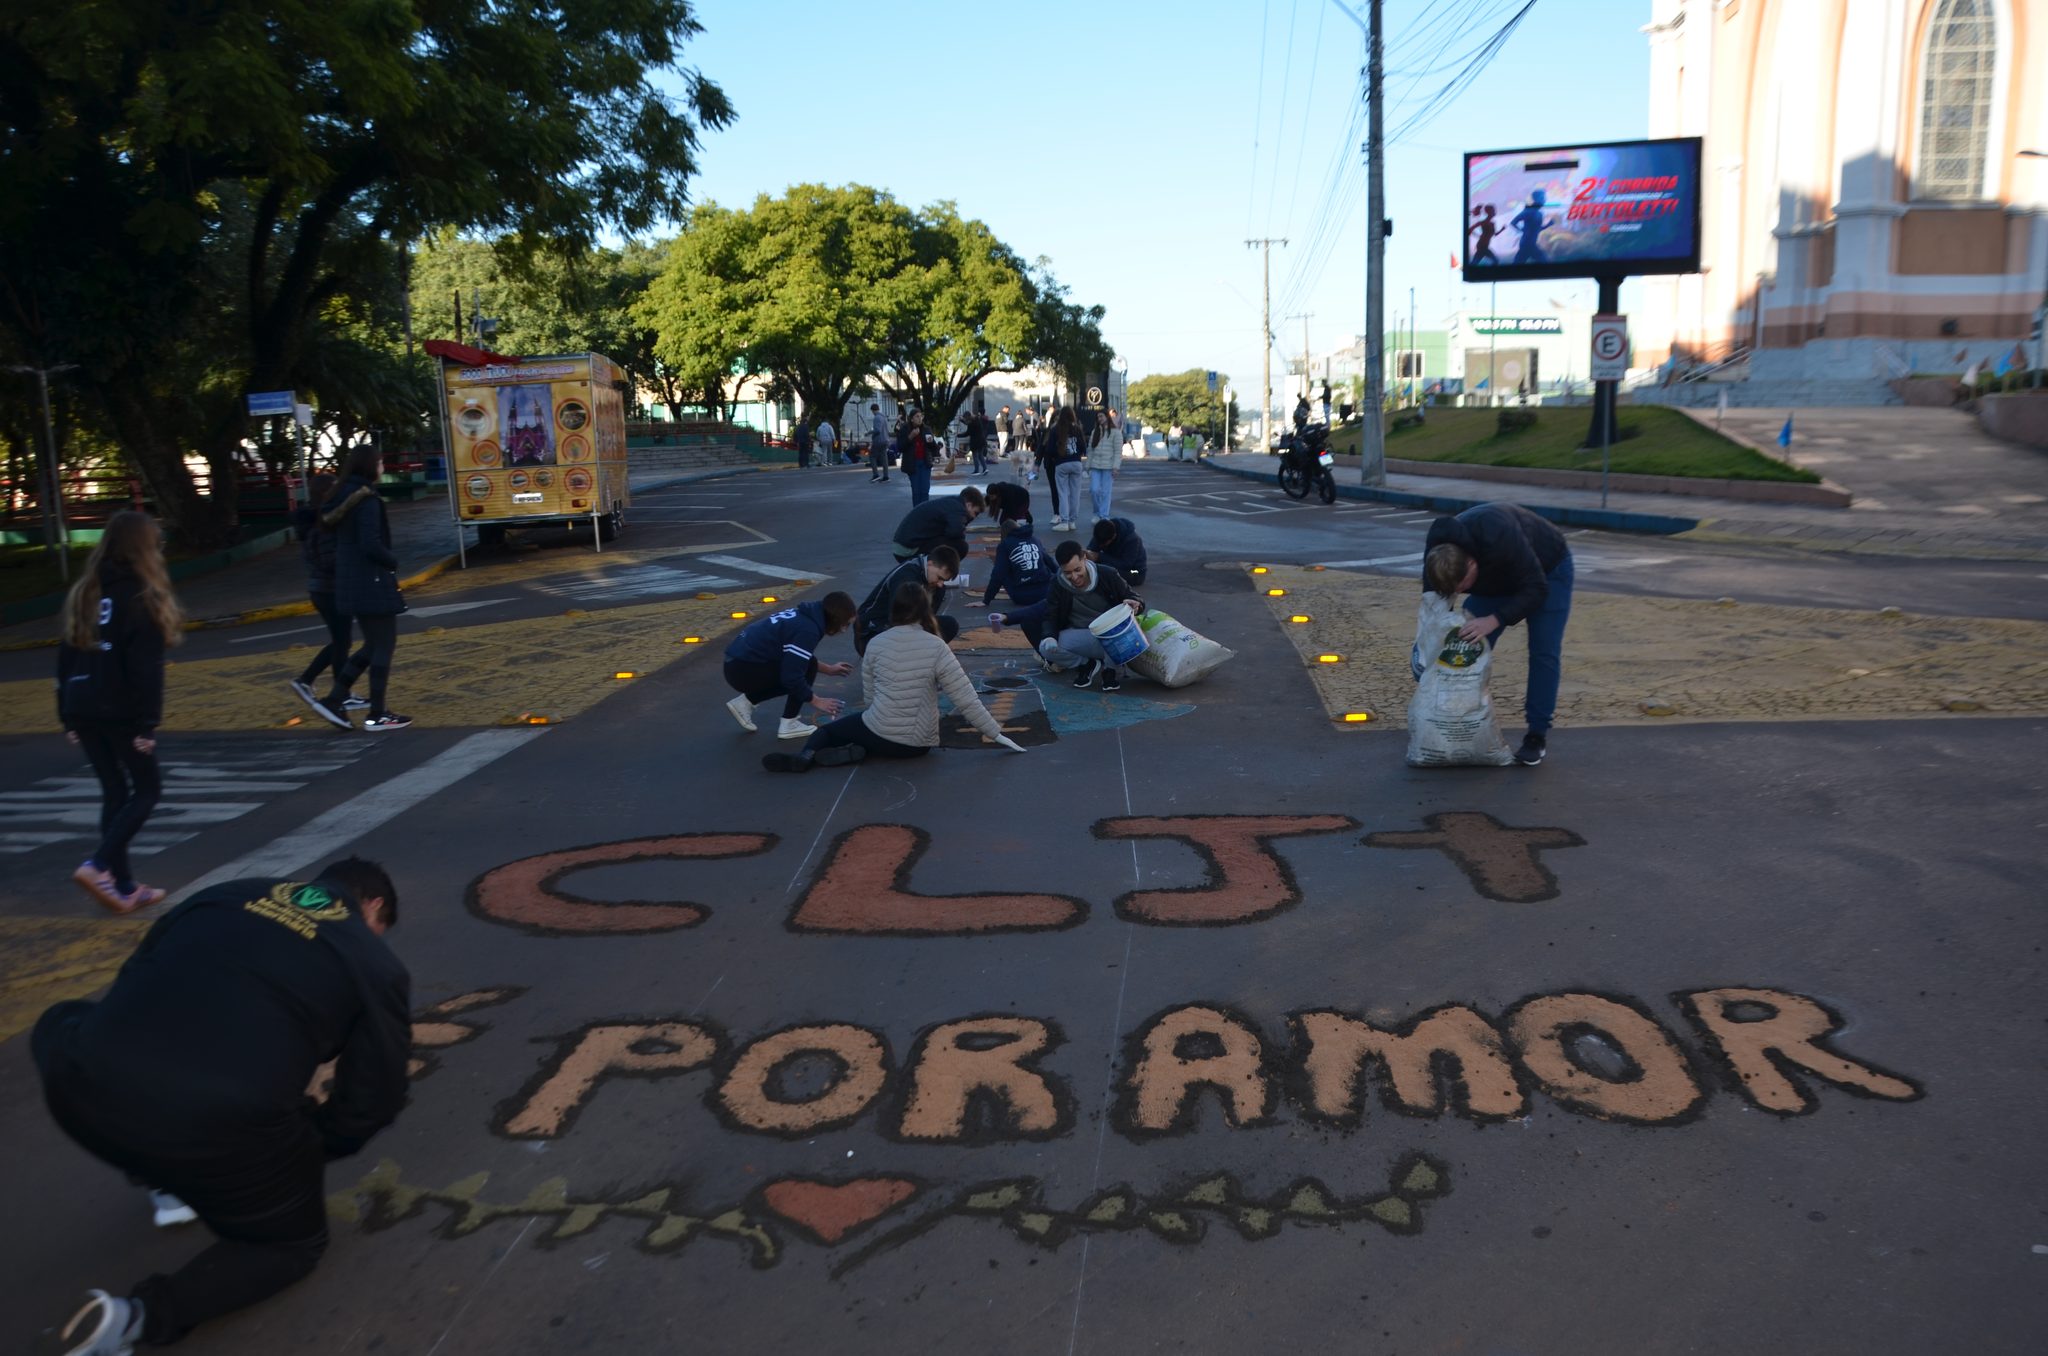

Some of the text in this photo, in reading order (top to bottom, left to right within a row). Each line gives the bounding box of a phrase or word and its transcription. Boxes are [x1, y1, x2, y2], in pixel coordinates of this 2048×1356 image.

[1567, 198, 1679, 221] BERTOLETTI
[1602, 335, 1617, 354] E
[491, 1014, 1077, 1144] POR
[1110, 985, 1927, 1139] AMOR
